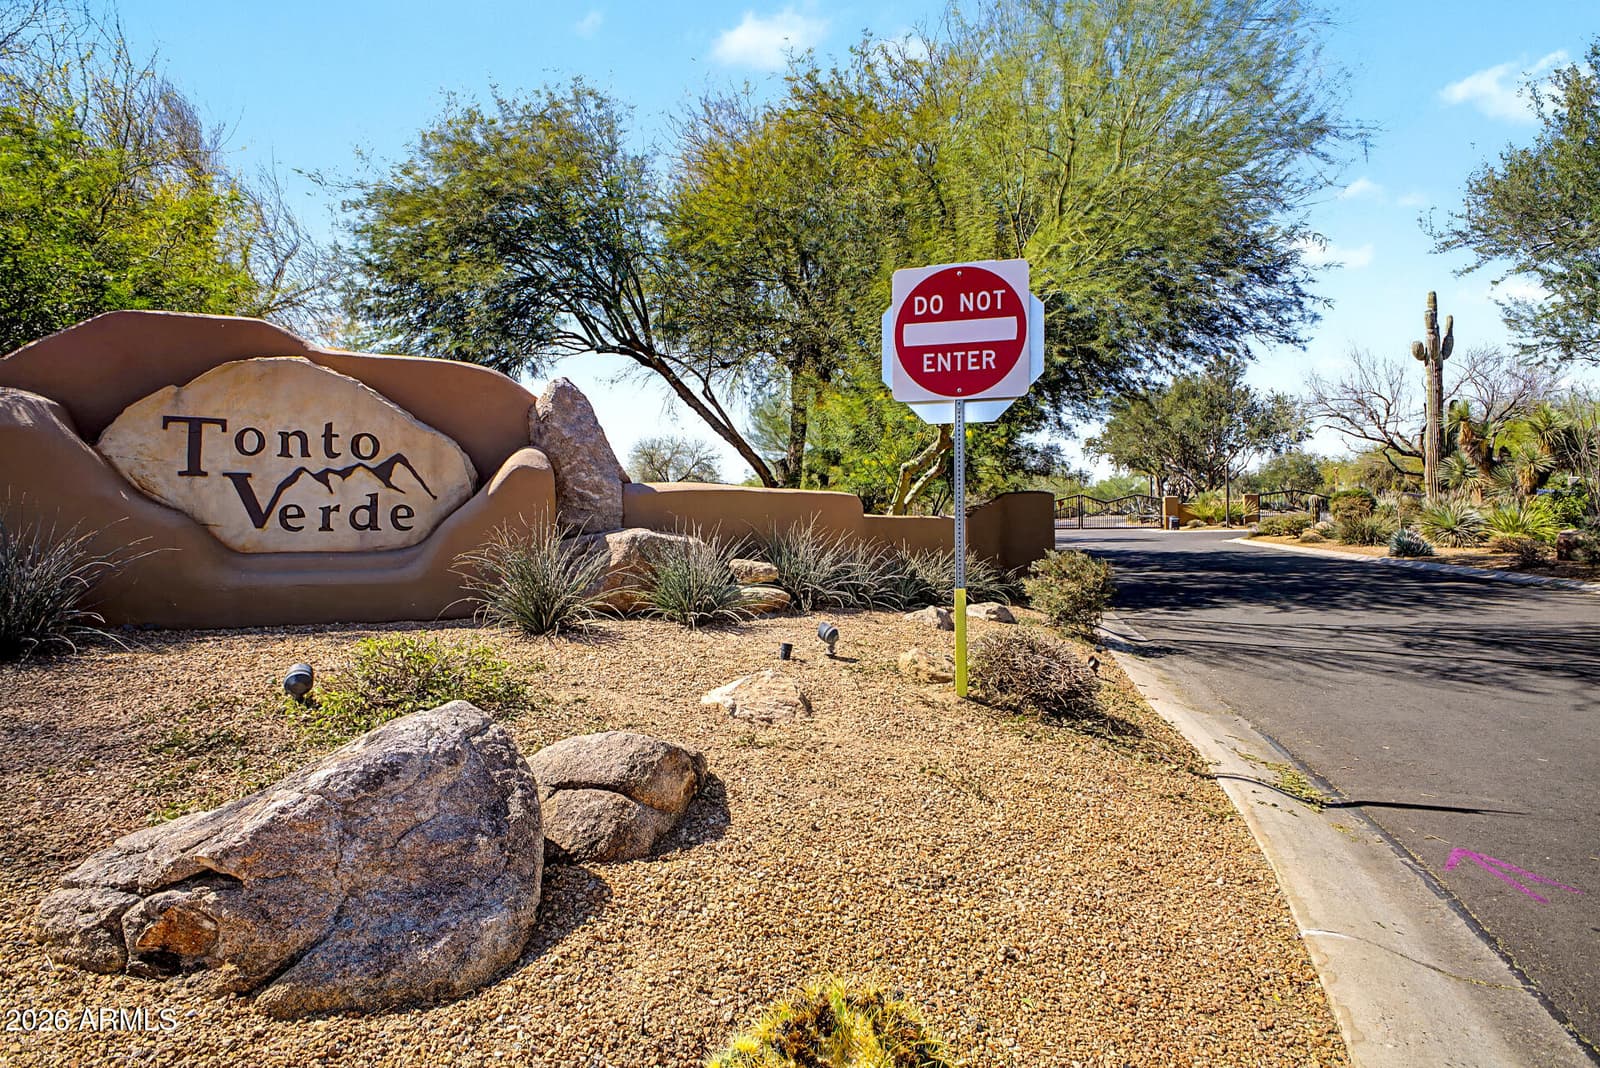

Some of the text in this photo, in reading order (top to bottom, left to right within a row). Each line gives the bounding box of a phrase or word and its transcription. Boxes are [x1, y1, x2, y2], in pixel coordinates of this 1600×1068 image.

[914, 290, 1005, 316] DO NOT
[923, 350, 996, 373] ENTER
[162, 415, 381, 477] Tonto
[222, 472, 415, 532] Verde
